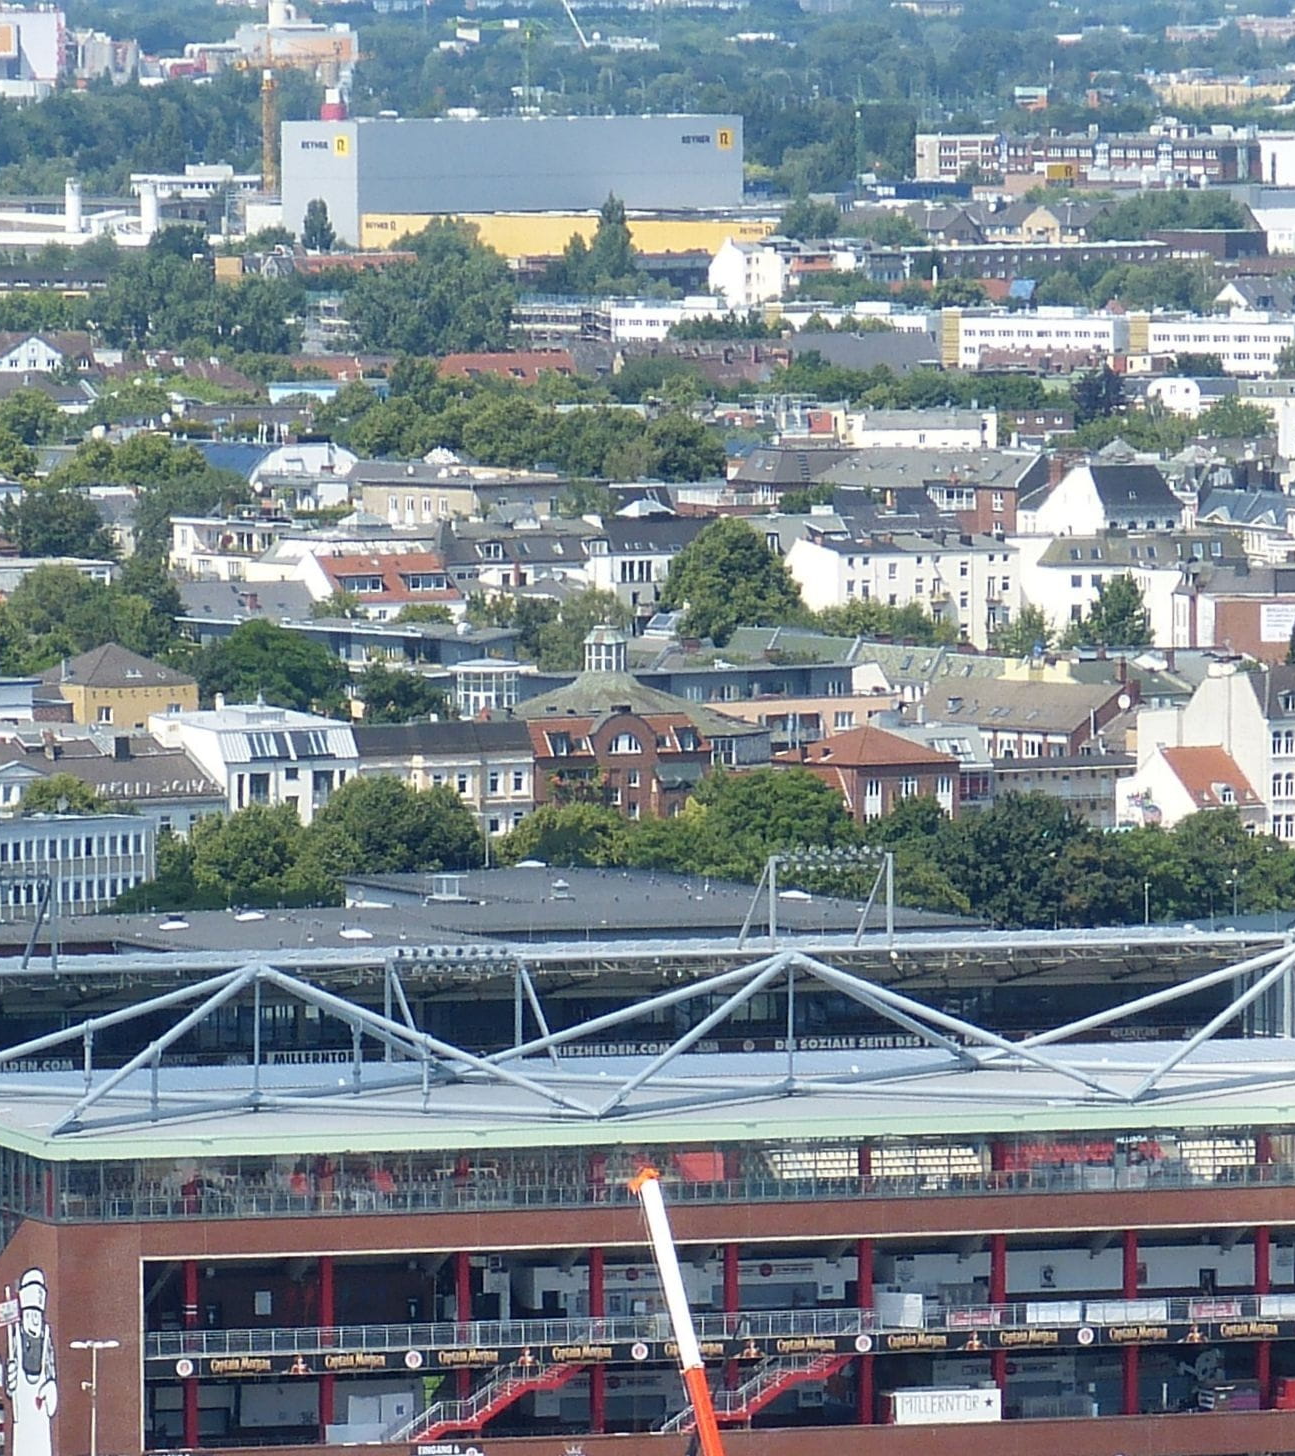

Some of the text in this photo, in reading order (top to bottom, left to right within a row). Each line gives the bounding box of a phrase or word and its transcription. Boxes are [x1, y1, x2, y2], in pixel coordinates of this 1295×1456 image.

[800, 1036, 855, 1049] SOZIALE
[859, 1036, 894, 1048] SEITE
[896, 1036, 920, 1047] DES
[901, 1395, 980, 1414] MILLERNTOR
